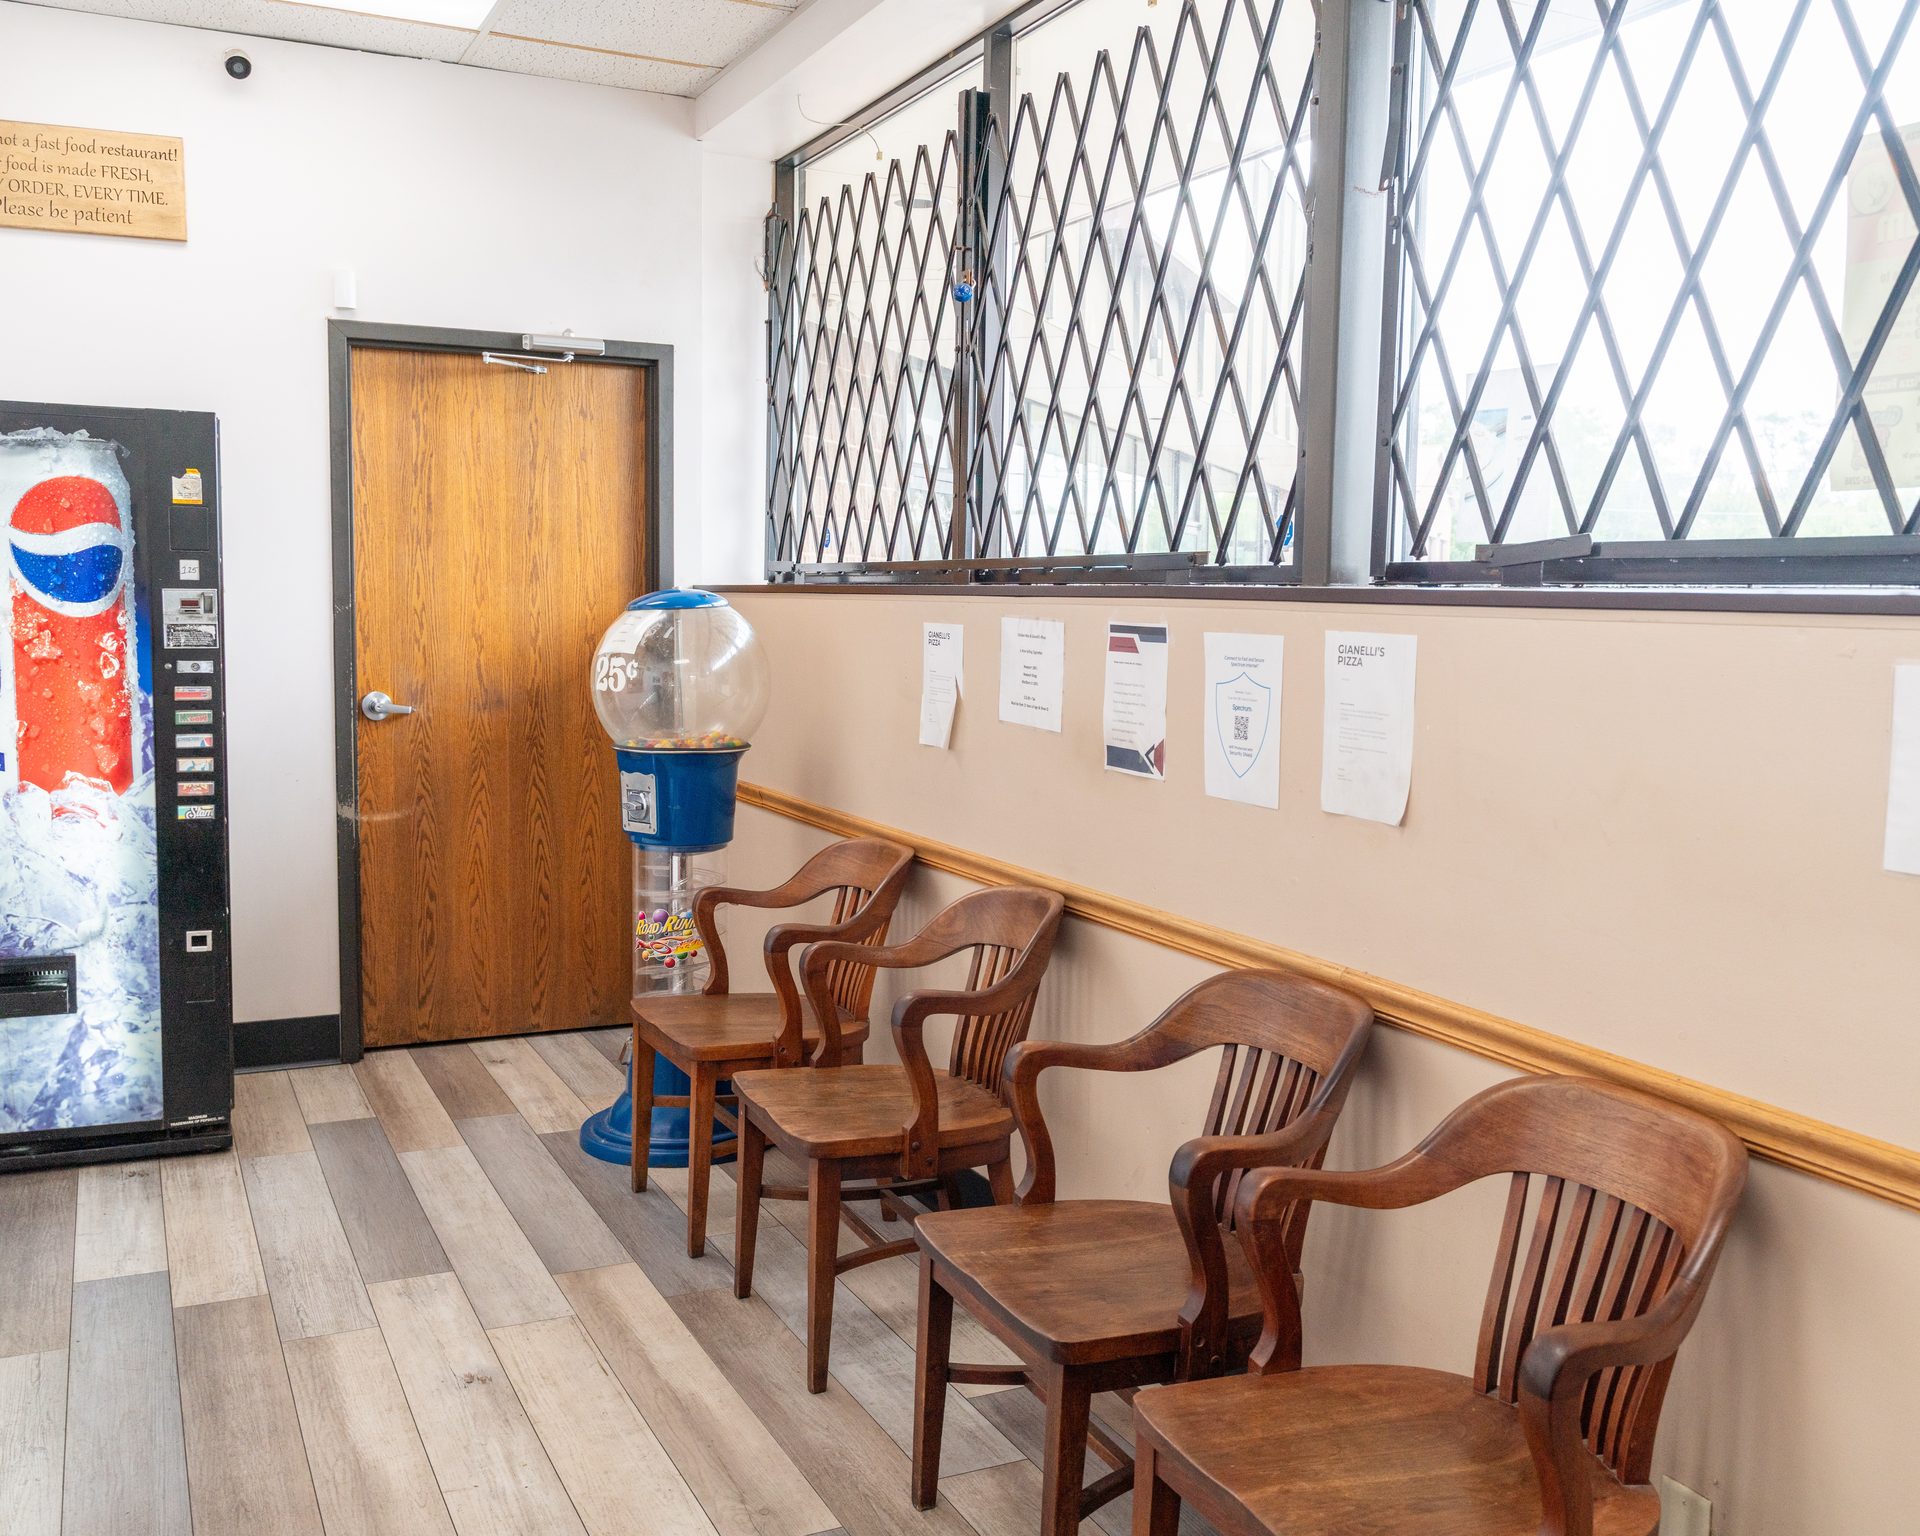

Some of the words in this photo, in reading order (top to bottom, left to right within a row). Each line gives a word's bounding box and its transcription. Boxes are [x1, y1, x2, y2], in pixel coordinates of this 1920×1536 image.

[22, 138, 30, 147] a
[31, 133, 60, 153] fast
[61, 136, 97, 156] food
[100, 144, 178, 162] restaurant!
[2, 154, 38, 174] food
[42, 160, 53, 174] is
[58, 162, 97, 178] made
[101, 165, 154, 184] FRESH,
[8, 178, 69, 198] ORDER,
[74, 184, 123, 201] EVERY
[126, 189, 169, 206] TIME.
[49, 200, 69, 219] be
[74, 207, 133, 226] patient
[928, 638, 941, 647] PIZZA
[1338, 644, 1385, 657] GIANELLI'S
[1337, 655, 1363, 667] PIZZA
[635, 919, 661, 936] ROAD
[662, 915, 696, 933] RUNN
